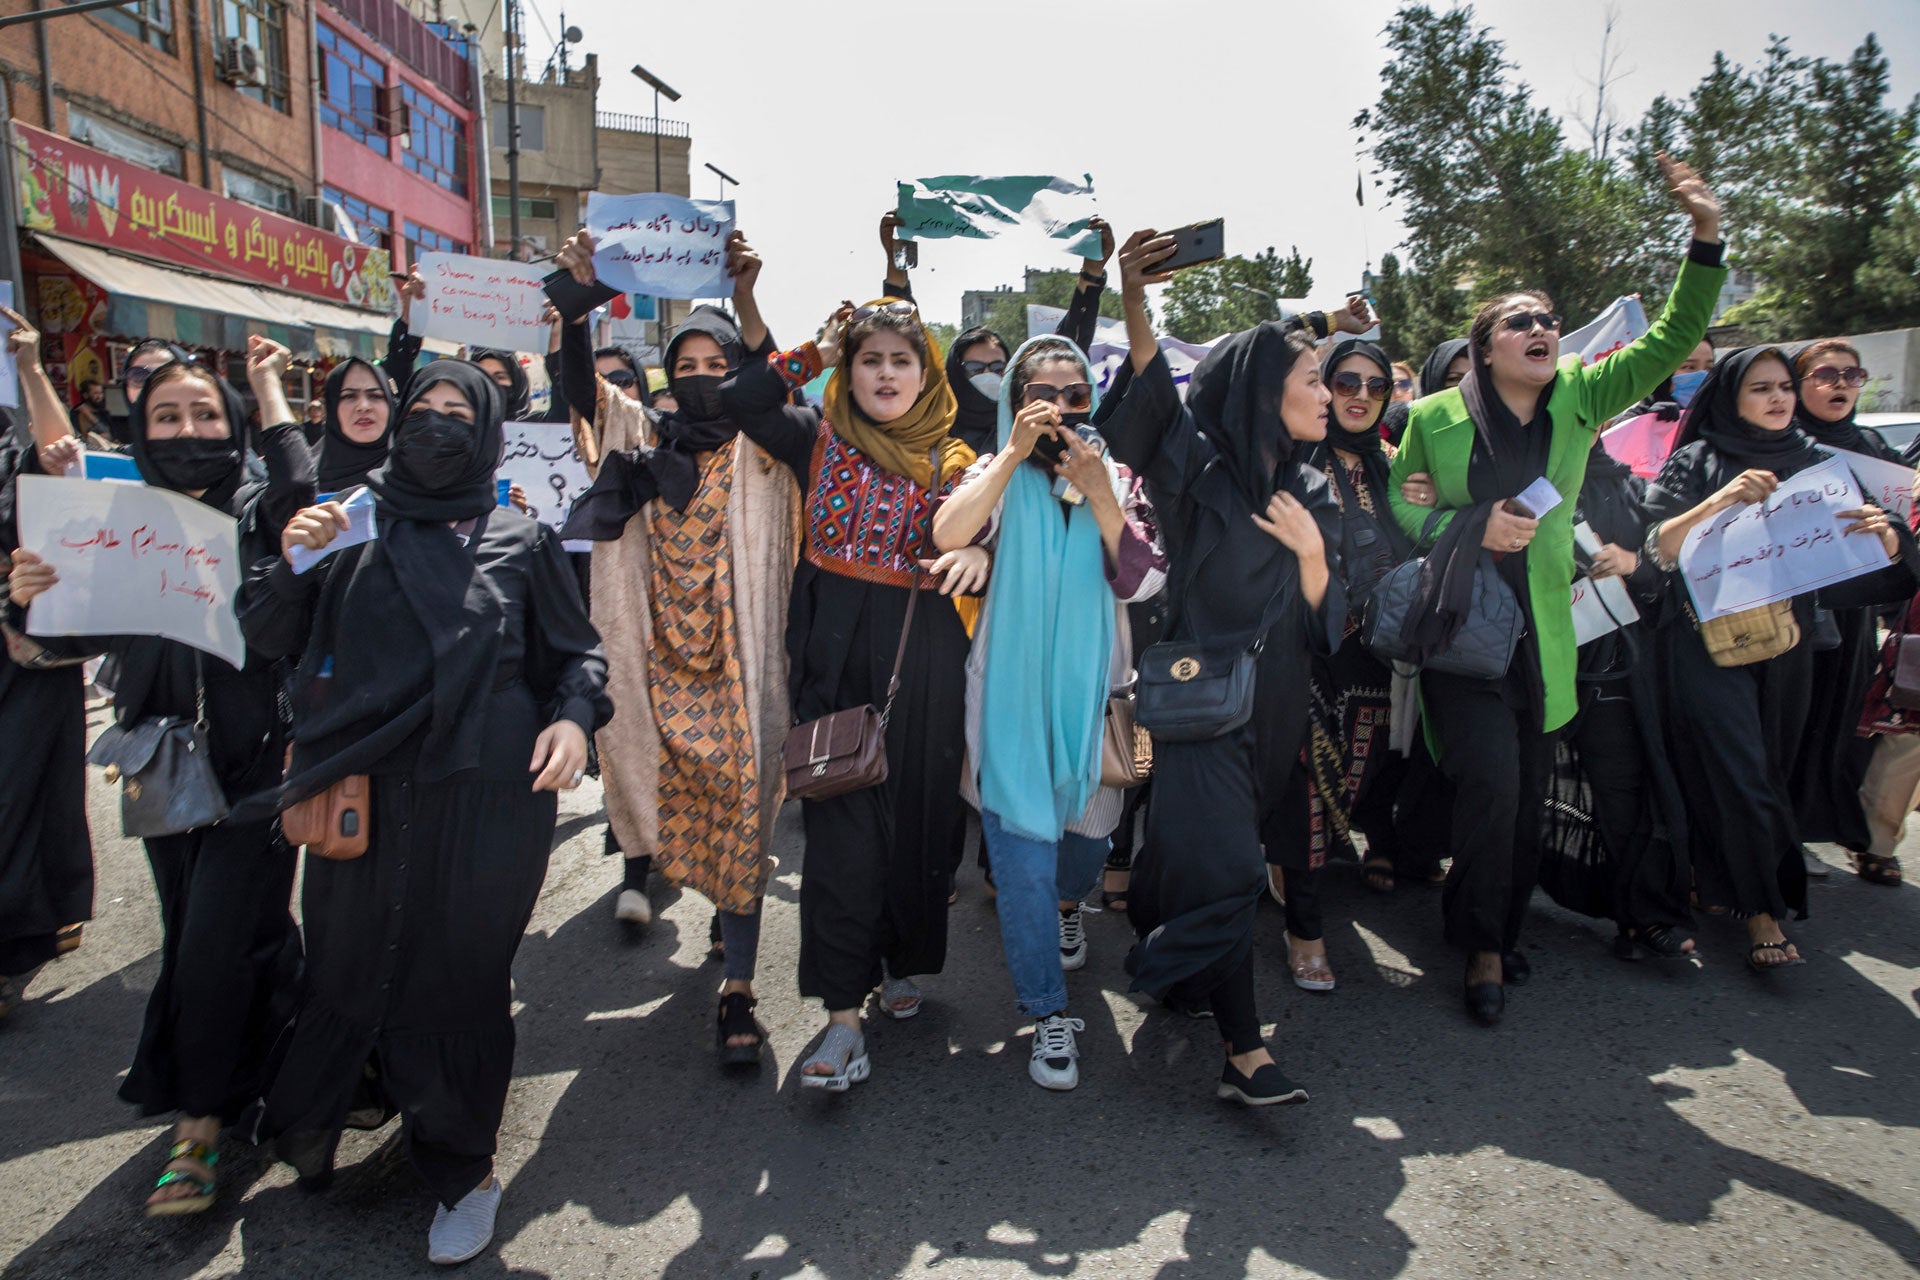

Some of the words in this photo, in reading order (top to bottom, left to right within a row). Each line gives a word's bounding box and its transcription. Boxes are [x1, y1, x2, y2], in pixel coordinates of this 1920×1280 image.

[224, 217, 238, 259] و
[244, 216, 279, 272] برگر
[283, 230, 329, 289] پاکیزه
[437, 262, 474, 279] Shame
[1807, 480, 1849, 504] زنان
[60, 528, 121, 555] طالب
